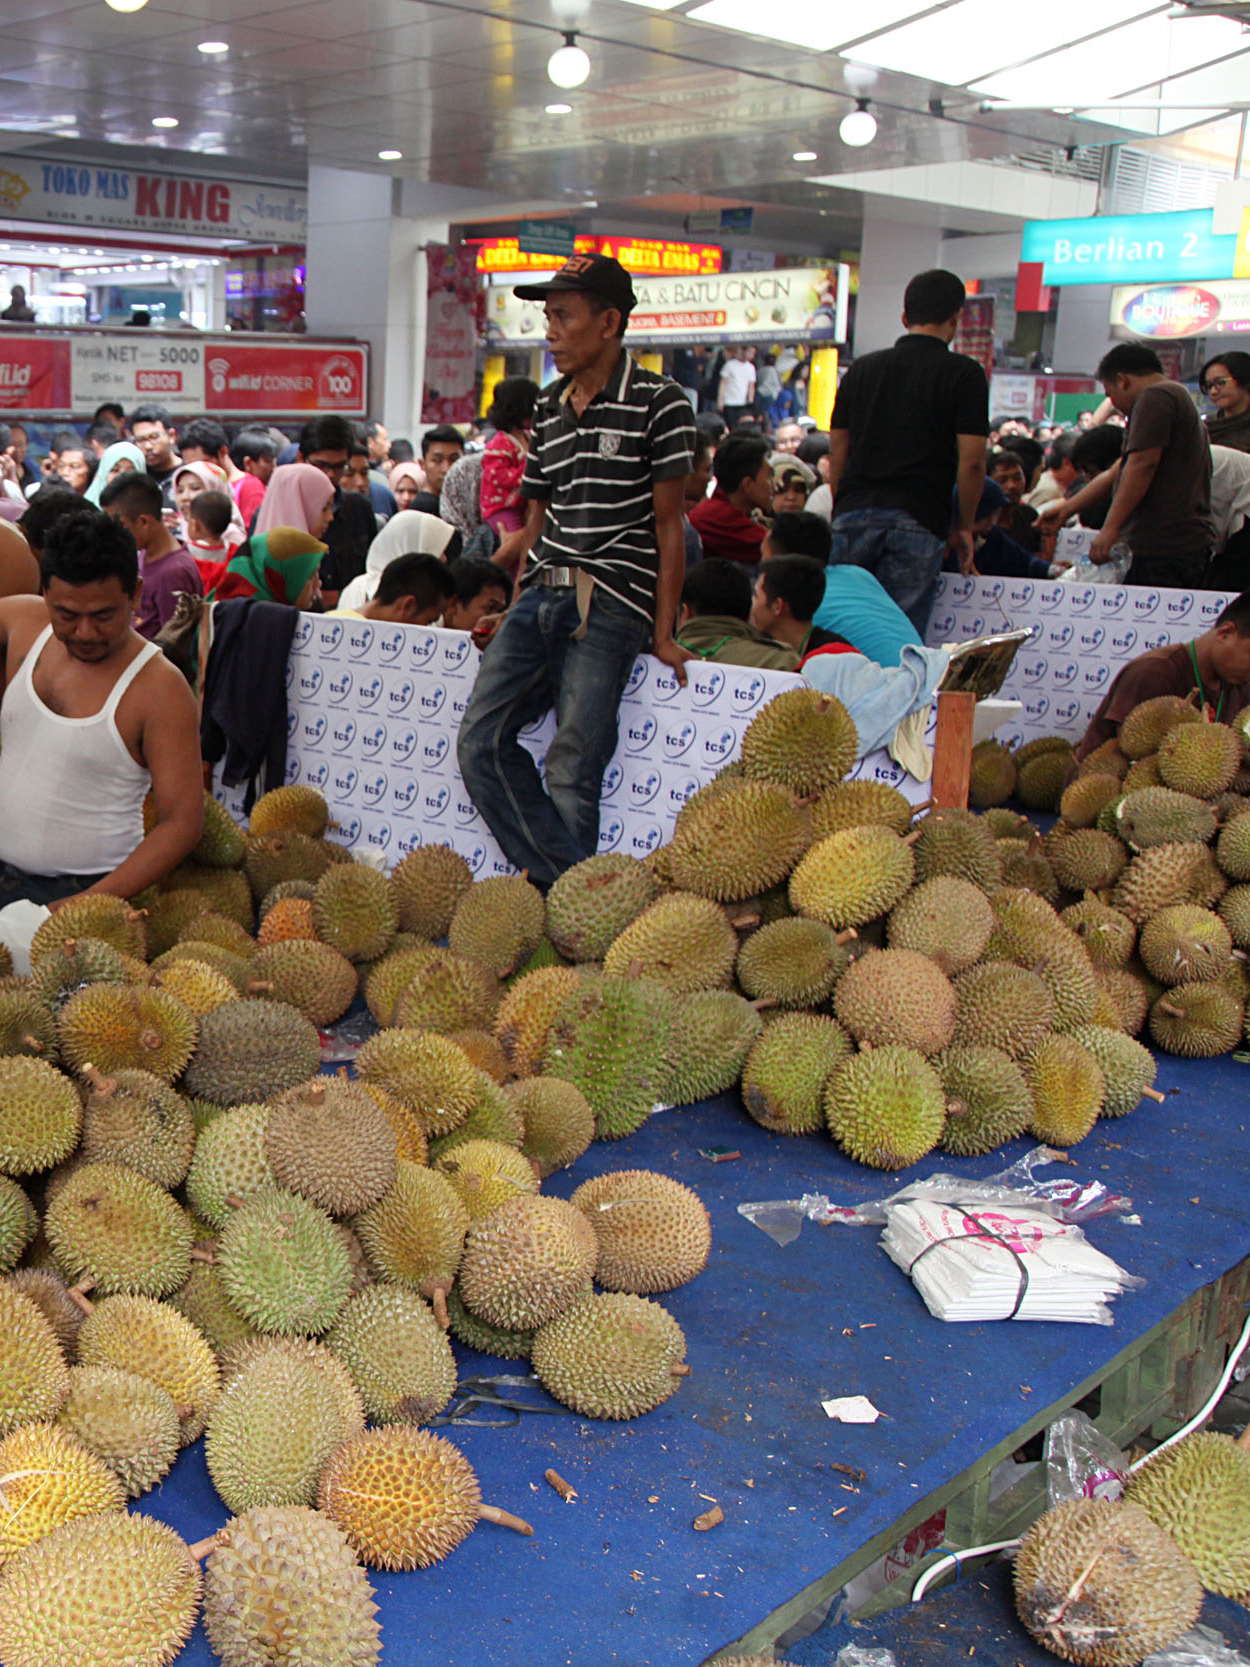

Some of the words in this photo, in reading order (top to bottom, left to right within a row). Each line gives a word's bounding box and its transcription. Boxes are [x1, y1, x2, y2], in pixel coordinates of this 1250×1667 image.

[42, 164, 91, 196] TOKO
[97, 170, 129, 200] MAS
[135, 175, 230, 223] KING
[1053, 237, 1164, 264] Berlian
[1179, 232, 1198, 258] 2
[617, 246, 660, 267] DELTA
[674, 282, 720, 305] BATU
[725, 277, 791, 302] CINCIN
[107, 346, 138, 362] NET
[160, 347, 199, 363] 5000
[263, 375, 314, 392] CORNER
[328, 375, 352, 393] 100
[954, 586, 969, 596] tcs
[1012, 590, 1028, 601] tcs
[1042, 592, 1058, 603] tcs
[1072, 595, 1088, 606] tcs
[1104, 598, 1121, 609] tcs
[1136, 600, 1153, 611] tcs
[1169, 603, 1186, 614] tcs
[1203, 605, 1220, 616] tcs
[935, 621, 949, 631] tcs
[963, 624, 978, 634] tcs
[321, 633, 337, 644] tcs
[351, 637, 367, 648] tcs
[1051, 632, 1067, 643] tcs
[1081, 634, 1098, 645] tcs
[381, 640, 398, 652] tcs
[1113, 638, 1130, 649] tcs
[413, 644, 430, 656] tcs
[445, 648, 463, 661] tcs
[1025, 666, 1041, 677] tcs
[1055, 669, 1071, 680] tcs
[1086, 672, 1102, 683] tcs
[301, 678, 317, 689] tcs
[330, 682, 346, 693] tcs
[657, 678, 676, 690] tcs
[696, 683, 715, 695] tcs
[360, 687, 376, 698] tcs
[390, 691, 407, 703] tcs
[735, 688, 756, 701] tcs
[422, 696, 439, 708] tcs
[1027, 704, 1043, 715] tcs
[1057, 707, 1073, 718] tcs
[305, 725, 321, 736] tcs
[334, 730, 350, 741] tcs
[629, 729, 648, 741] tcs
[364, 736, 380, 747] tcs
[394, 741, 410, 752] tcs
[667, 735, 686, 747] tcs
[706, 740, 726, 753] tcs
[425, 746, 442, 758] tcs
[307, 773, 323, 784] tcs
[875, 767, 899, 781] tcs
[336, 778, 352, 789] tcs
[633, 783, 652, 795] tcs
[365, 784, 381, 795] tcs
[395, 790, 412, 801] tcs
[671, 790, 690, 802] tcs
[426, 796, 443, 808] tcs
[458, 803, 475, 815] tcs
[339, 827, 355, 838] tcs
[369, 834, 385, 845] tcs
[634, 837, 652, 849] tcs
[398, 840, 415, 852] tcs
